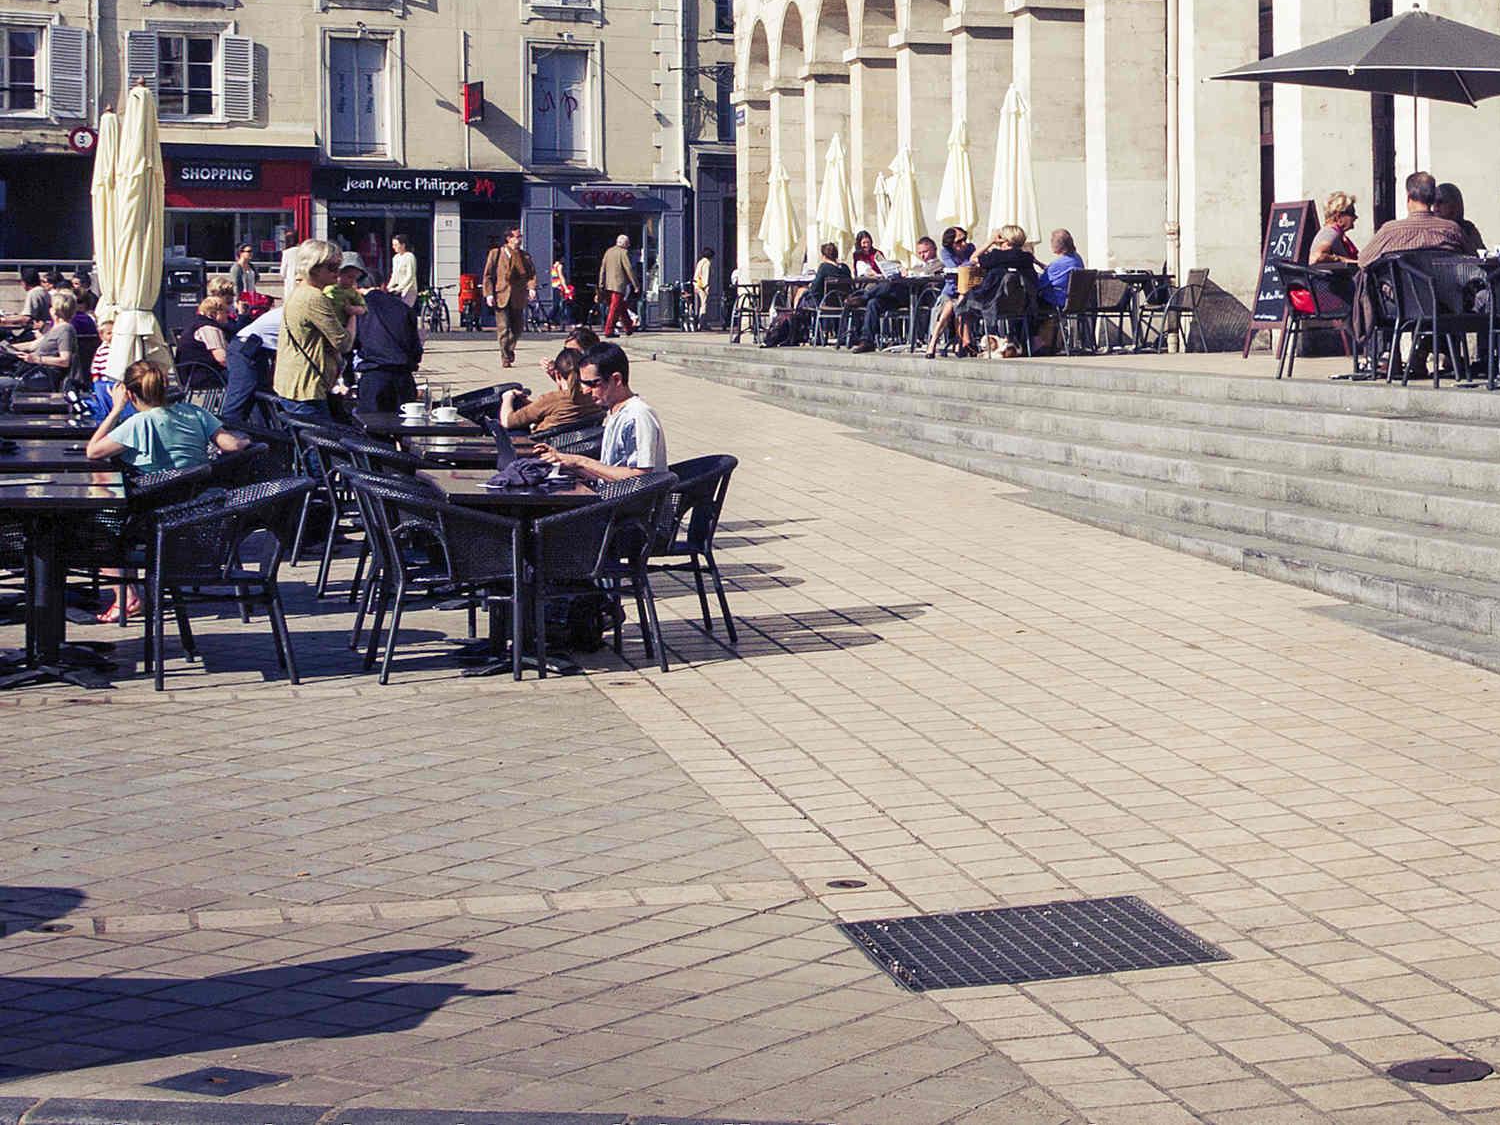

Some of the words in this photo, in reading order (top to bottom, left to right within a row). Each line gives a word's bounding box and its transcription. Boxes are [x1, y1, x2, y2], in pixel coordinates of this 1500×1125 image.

[181, 167, 254, 181] SHOPPING
[343, 177, 374, 192] Jean
[377, 177, 412, 191] Marc
[415, 177, 469, 195] Philippe
